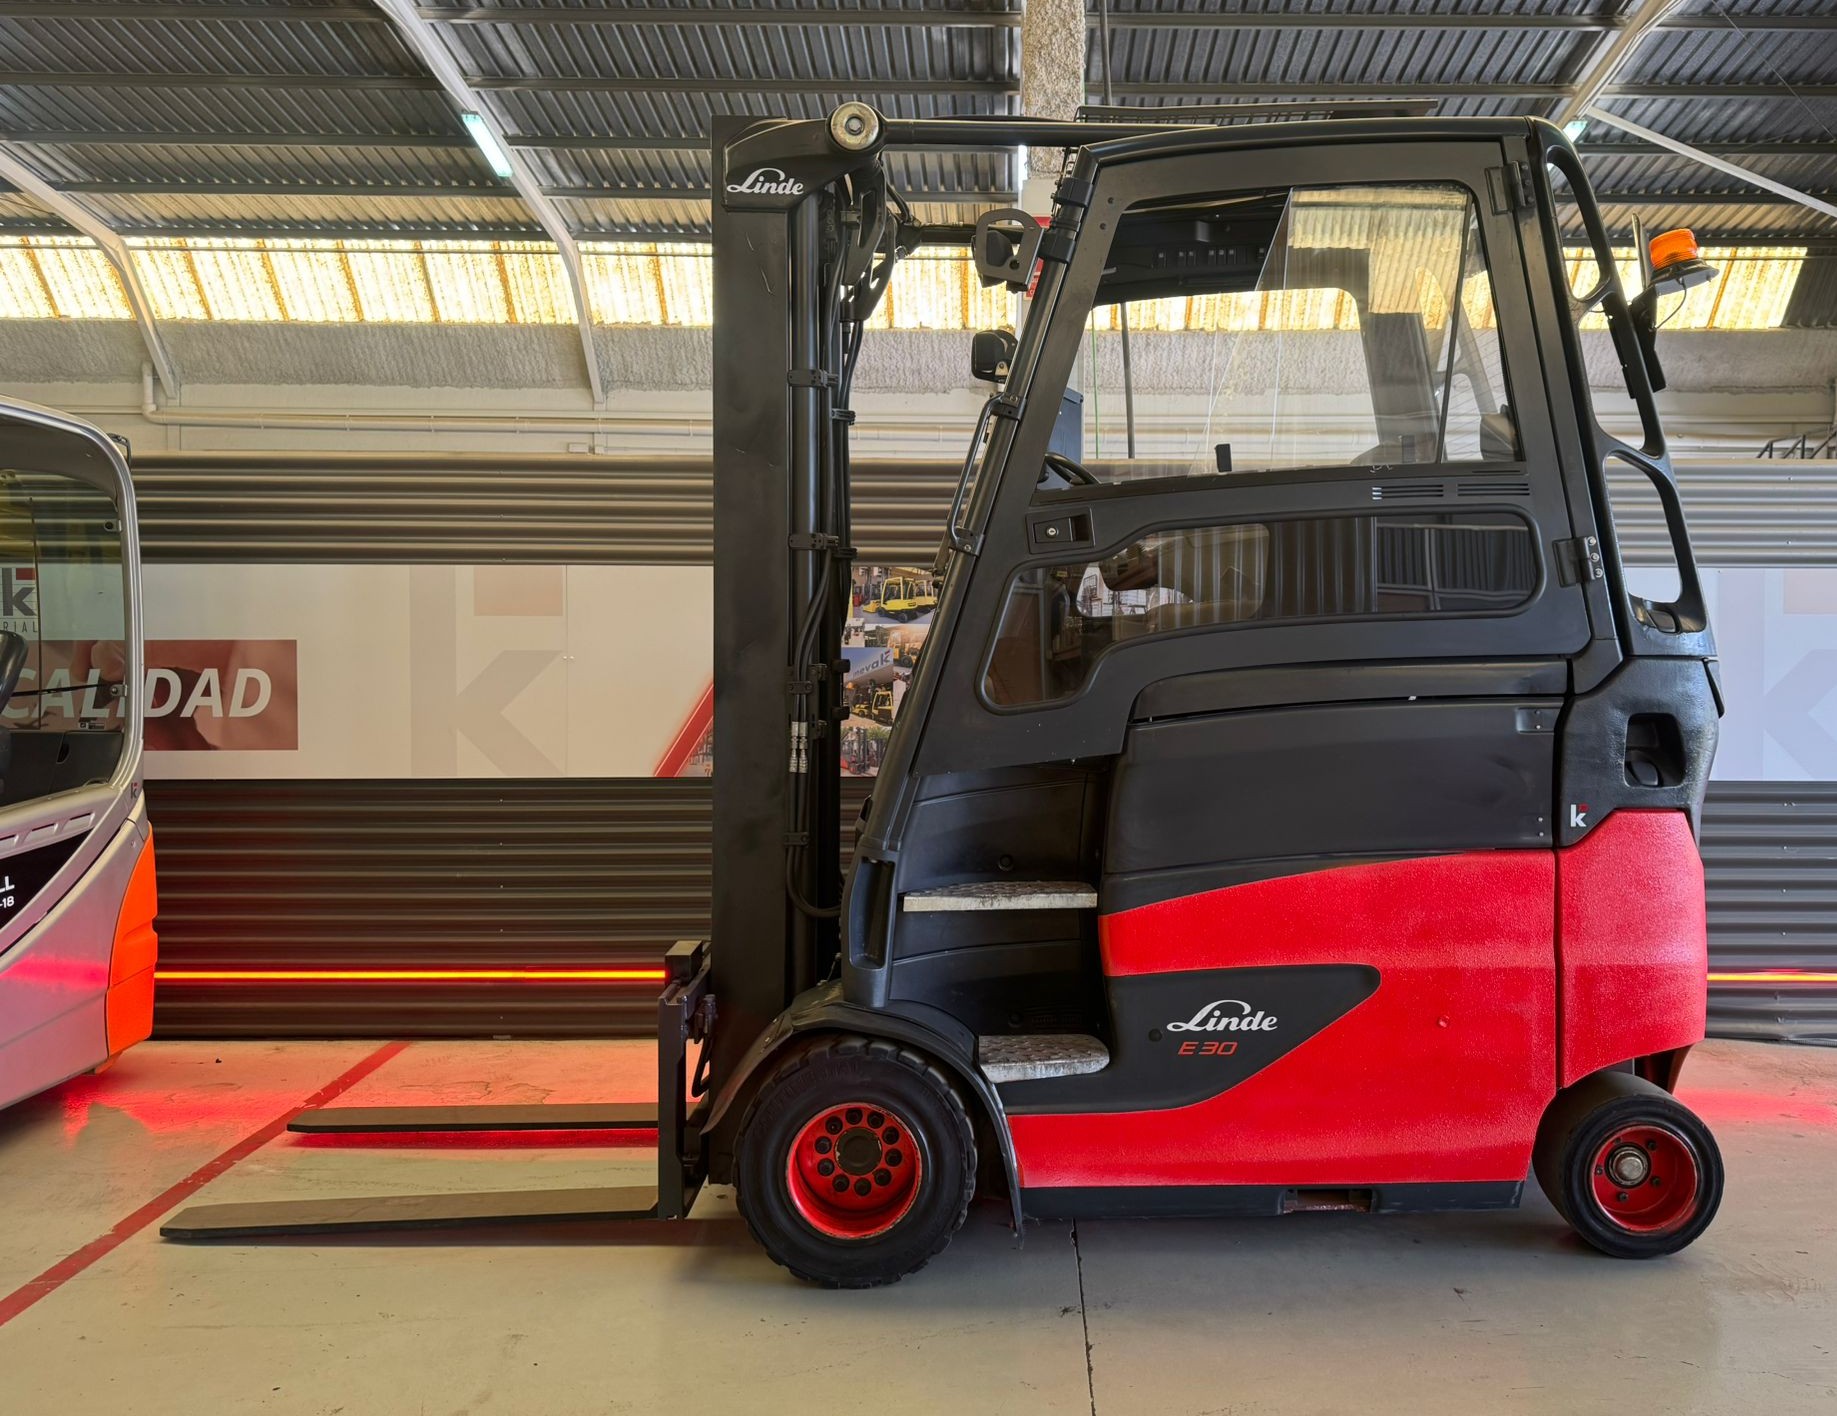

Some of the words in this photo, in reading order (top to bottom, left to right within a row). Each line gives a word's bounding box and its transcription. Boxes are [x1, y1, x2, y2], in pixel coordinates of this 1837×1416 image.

[726, 167, 804, 195] Linde
[0, 667, 272, 719] CALDAD
[1166, 999, 1278, 1032] Linde
[1178, 1041, 1199, 1055] E
[1199, 1041, 1239, 1055] 30
